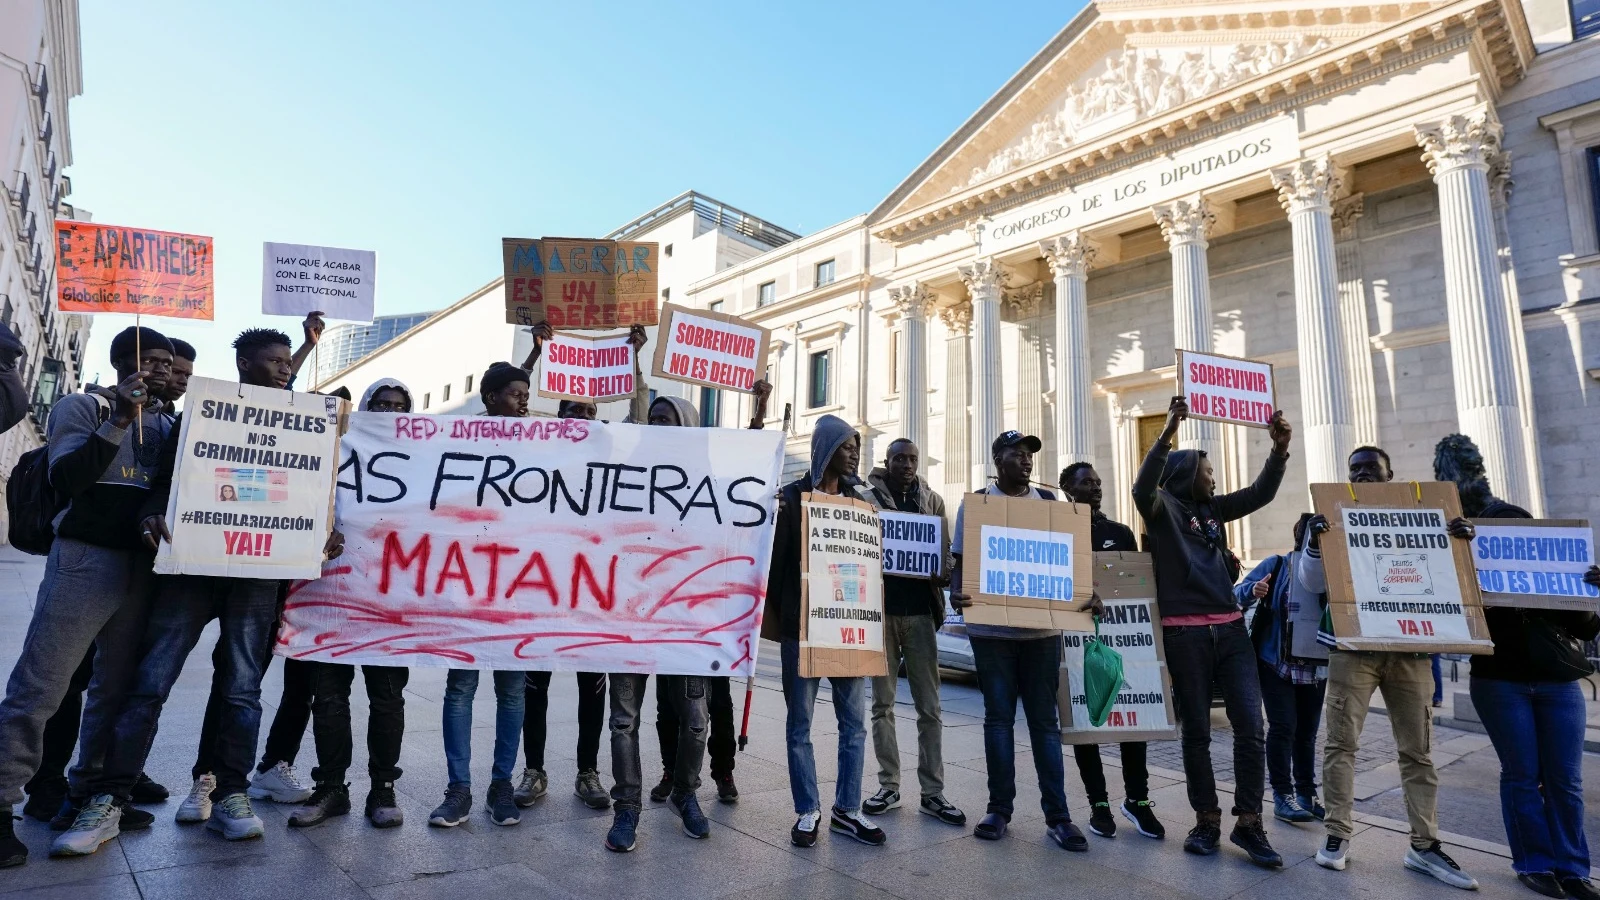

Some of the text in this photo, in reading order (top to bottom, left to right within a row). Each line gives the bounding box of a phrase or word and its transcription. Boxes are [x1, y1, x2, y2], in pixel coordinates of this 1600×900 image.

[992, 138, 1272, 240] CONGRESO DE LOS DIPUTADOS
[93, 228, 208, 277] APARTHEID?
[276, 257, 361, 271] HAY QUE ACABAR
[275, 270, 361, 285] CON EL RACISMO
[62, 286, 207, 312] Globalice human rights!
[275, 284, 358, 298] INSTITUCIONAL
[512, 278, 596, 304] ES UN
[546, 298, 657, 327] DERECHO
[675, 321, 756, 360] SOBREVIVIR
[548, 342, 629, 369] SOBREVIVIR
[546, 371, 633, 397] NO ES DELITO
[669, 352, 755, 390] NO ES DELITO
[1189, 362, 1267, 393] SOBREVIVIR
[201, 399, 327, 434] SIN PAPELES
[1190, 392, 1273, 425] NO ES DELITO
[247, 432, 277, 447] NOS
[193, 441, 321, 471] CRIMINALIZAN
[336, 448, 768, 527] AS FRONTERAS
[181, 511, 314, 531] #REGULARIZACIÓN
[810, 506, 878, 528] ME OBLIGAN
[1348, 512, 1441, 527] SOBREVIVIR
[223, 530, 273, 556] YA!!
[811, 526, 879, 547] A SER ILEGAL
[879, 518, 936, 544] BREVIVIR
[1348, 532, 1448, 549] NO ES DELITO
[810, 543, 880, 560] AL MENOS 3 AÑOS
[896, 549, 939, 575] DELITO
[988, 535, 1068, 567] SOBREVIVIR
[1477, 536, 1588, 562] SOBREVIVIR
[378, 530, 619, 611] MATAN
[1383, 574, 1424, 583] SOBREVIVIR
[1478, 569, 1599, 597] NO ES DELITO
[986, 570, 1073, 600] NO ES DELITO
[811, 606, 882, 623] #REGULARIZACIÓN
[1360, 601, 1461, 615] #REGULARIZACIÓN
[840, 627, 856, 644] YA
[1064, 635, 1080, 648] NO
[1099, 634, 1114, 647] MI
[1115, 631, 1153, 647] SUEÑO
[1397, 620, 1419, 636] YA
[1072, 691, 1163, 705] #RRIZACIÓN
